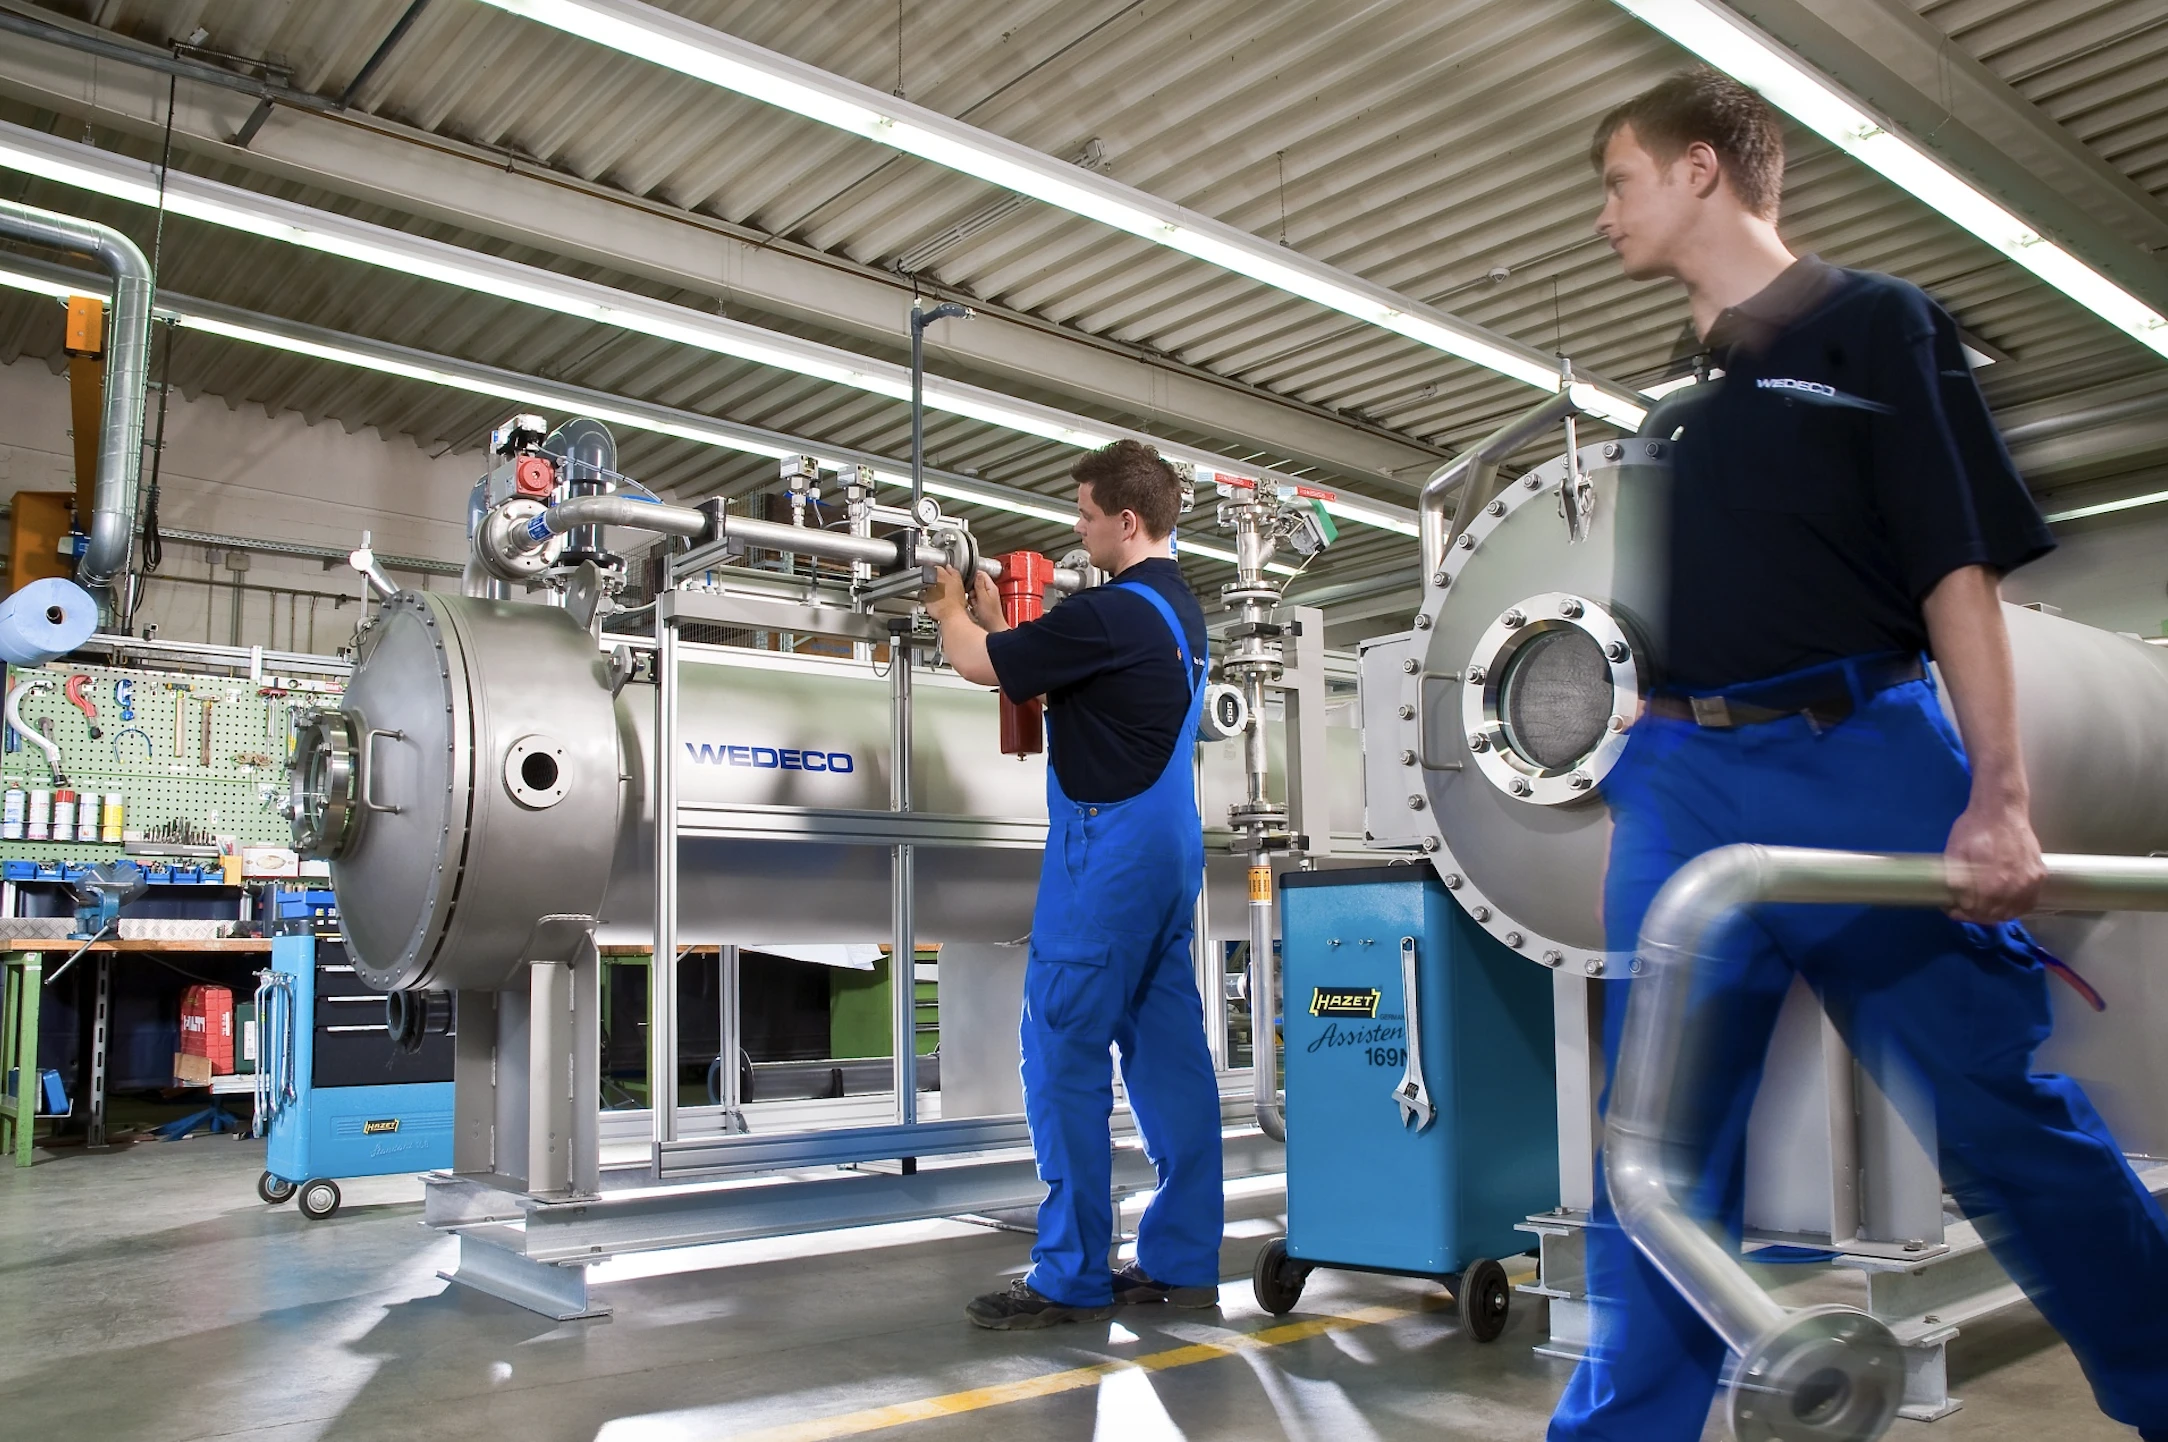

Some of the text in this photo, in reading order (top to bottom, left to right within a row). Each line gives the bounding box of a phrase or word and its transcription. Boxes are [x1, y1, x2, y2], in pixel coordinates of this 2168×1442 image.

[1756, 378, 1837, 397] WEDECO
[685, 742, 854, 773] WEDECO
[1314, 992, 1375, 1012] HAZET
[1307, 1022, 1405, 1053] Assisten
[366, 1121, 397, 1132] HAZET
